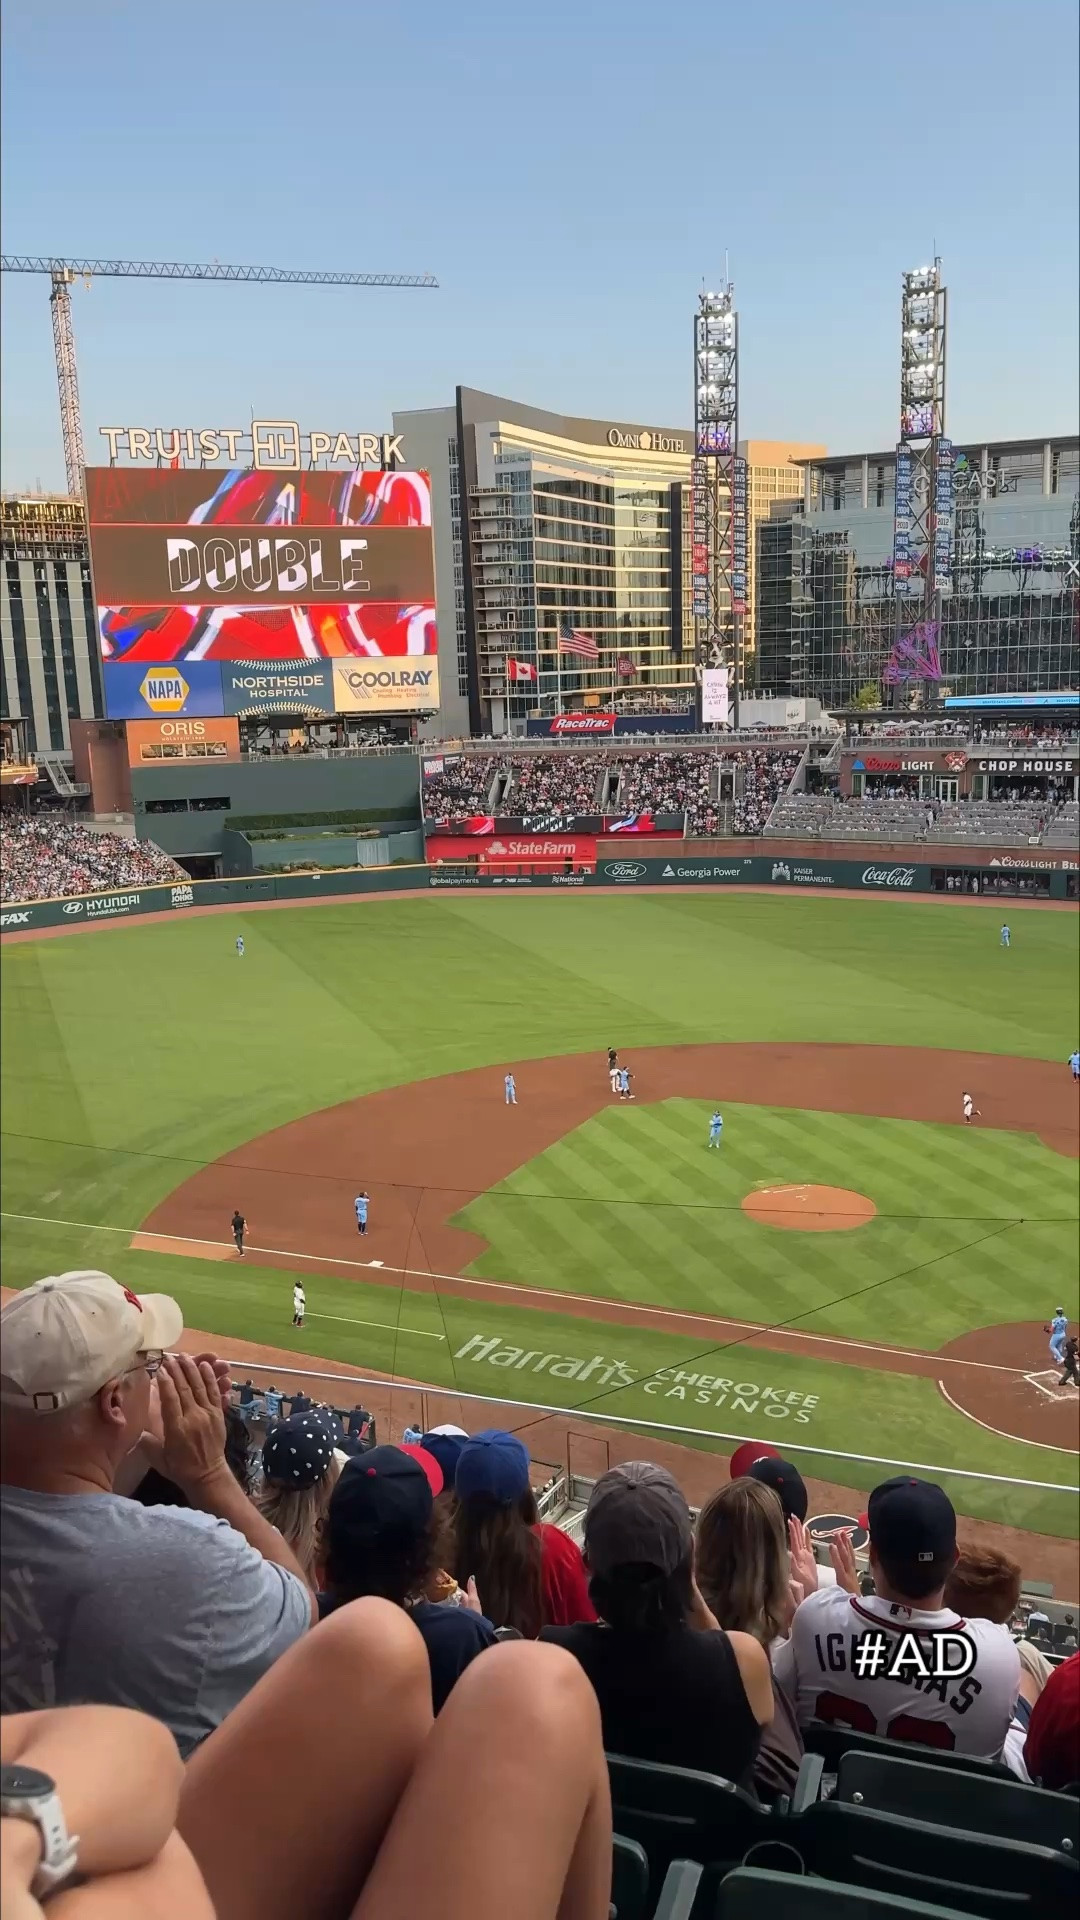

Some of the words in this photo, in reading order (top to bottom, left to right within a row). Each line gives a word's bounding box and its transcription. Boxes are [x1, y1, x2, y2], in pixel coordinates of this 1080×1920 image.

[100, 427, 243, 461] TRUIST
[309, 431, 406, 464] PARK
[608, 428, 640, 448] OMNI
[652, 432, 686, 452] HOTEL
[937, 518, 950, 526] 2012
[166, 538, 371, 593] DOUBLE
[232, 675, 324, 689] NORTHSIDE
[348, 670, 433, 688] COOLRAY
[148, 681, 183, 700] NAPA
[250, 688, 308, 698] HOSPITAL
[160, 722, 206, 736] ORIS
[556, 718, 609, 728] RaceTrac
[902, 761, 934, 770] LIGHT
[979, 761, 1018, 771] CHOP
[1023, 761, 1073, 772] HOUSE
[1002, 856, 1029, 867] Coors
[612, 864, 639, 876] Ford
[677, 868, 712, 878] Georgia
[714, 868, 740, 876] Power
[862, 866, 916, 886] Coca-Cola
[171, 885, 192, 896] PAPA
[86, 895, 140, 910] HYUNDAI
[171, 894, 194, 902] JOHNS
[1, 912, 29, 926] FAX
[655, 1367, 820, 1409] CHEROKEE
[643, 1382, 812, 1424] CASINOS
